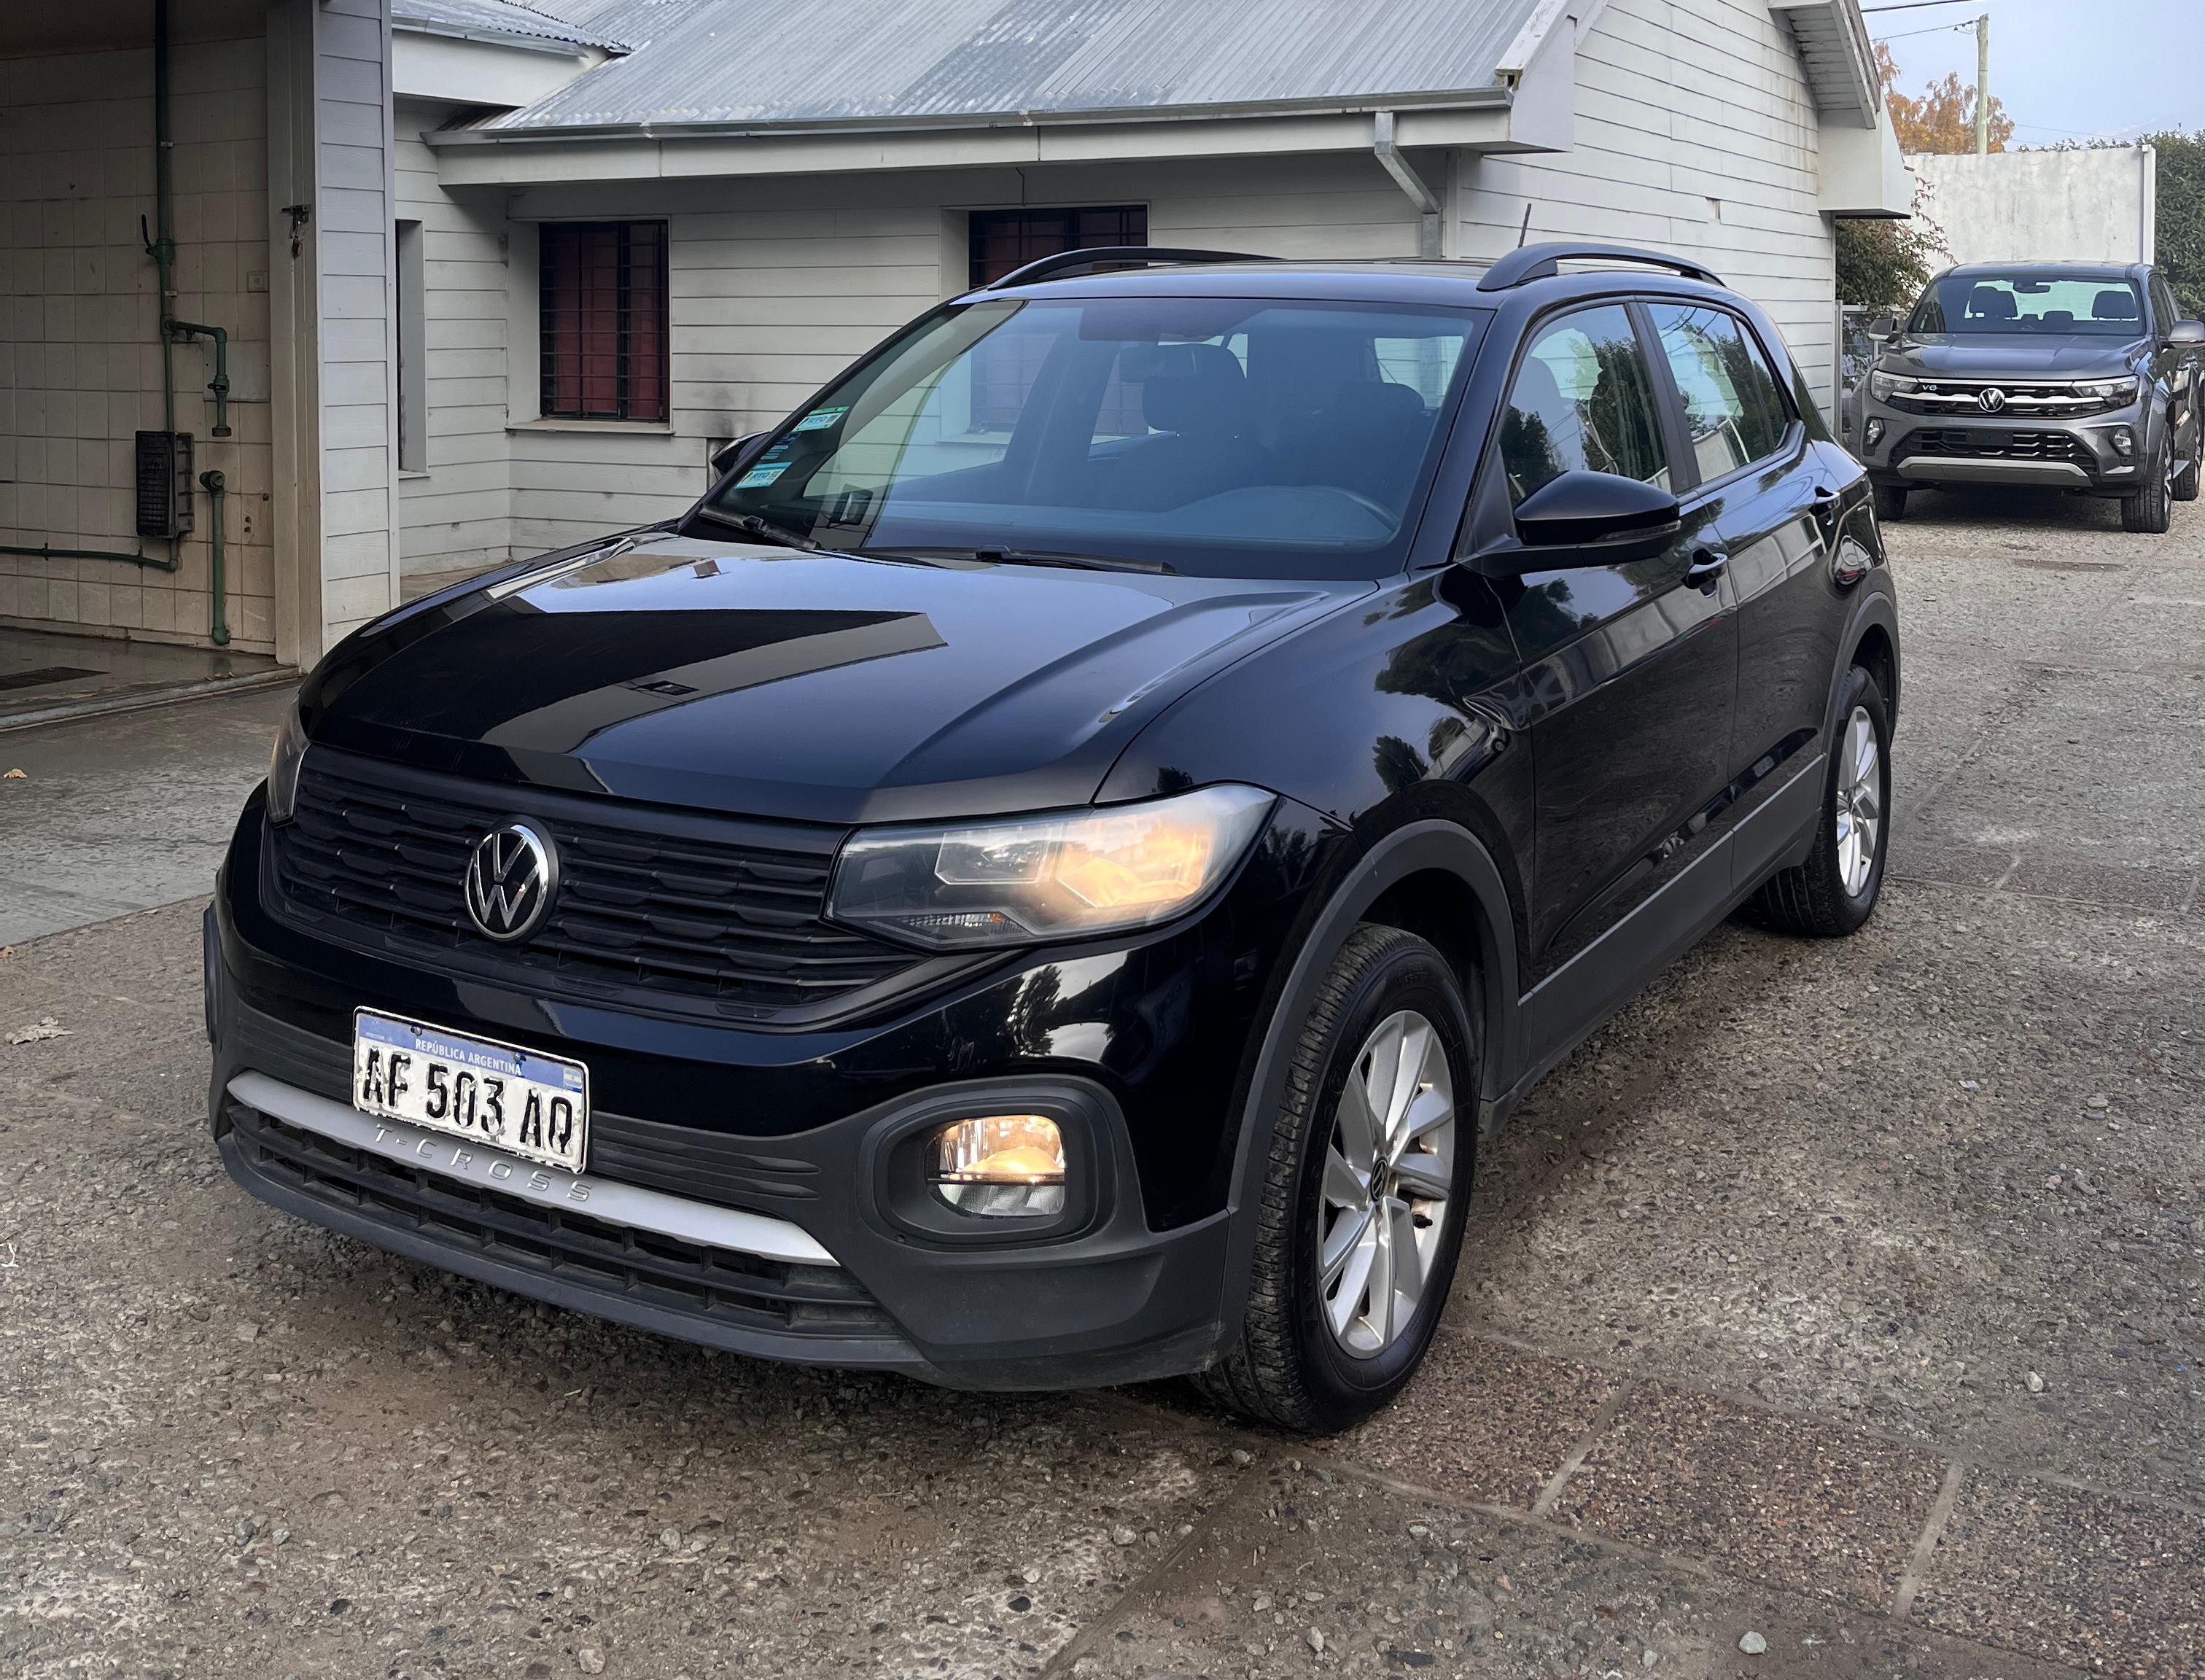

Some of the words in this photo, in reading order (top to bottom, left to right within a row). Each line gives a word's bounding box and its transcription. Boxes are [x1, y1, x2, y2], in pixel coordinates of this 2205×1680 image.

[472, 830, 541, 930] VW
[363, 1047, 411, 1108] AF
[426, 1062, 504, 1135] 503
[519, 1088, 572, 1154] AQ
[415, 1038, 465, 1061] REPÚBLICA
[467, 1052, 521, 1076] ARGENTINA
[373, 1124, 593, 1202] T-CROSS
